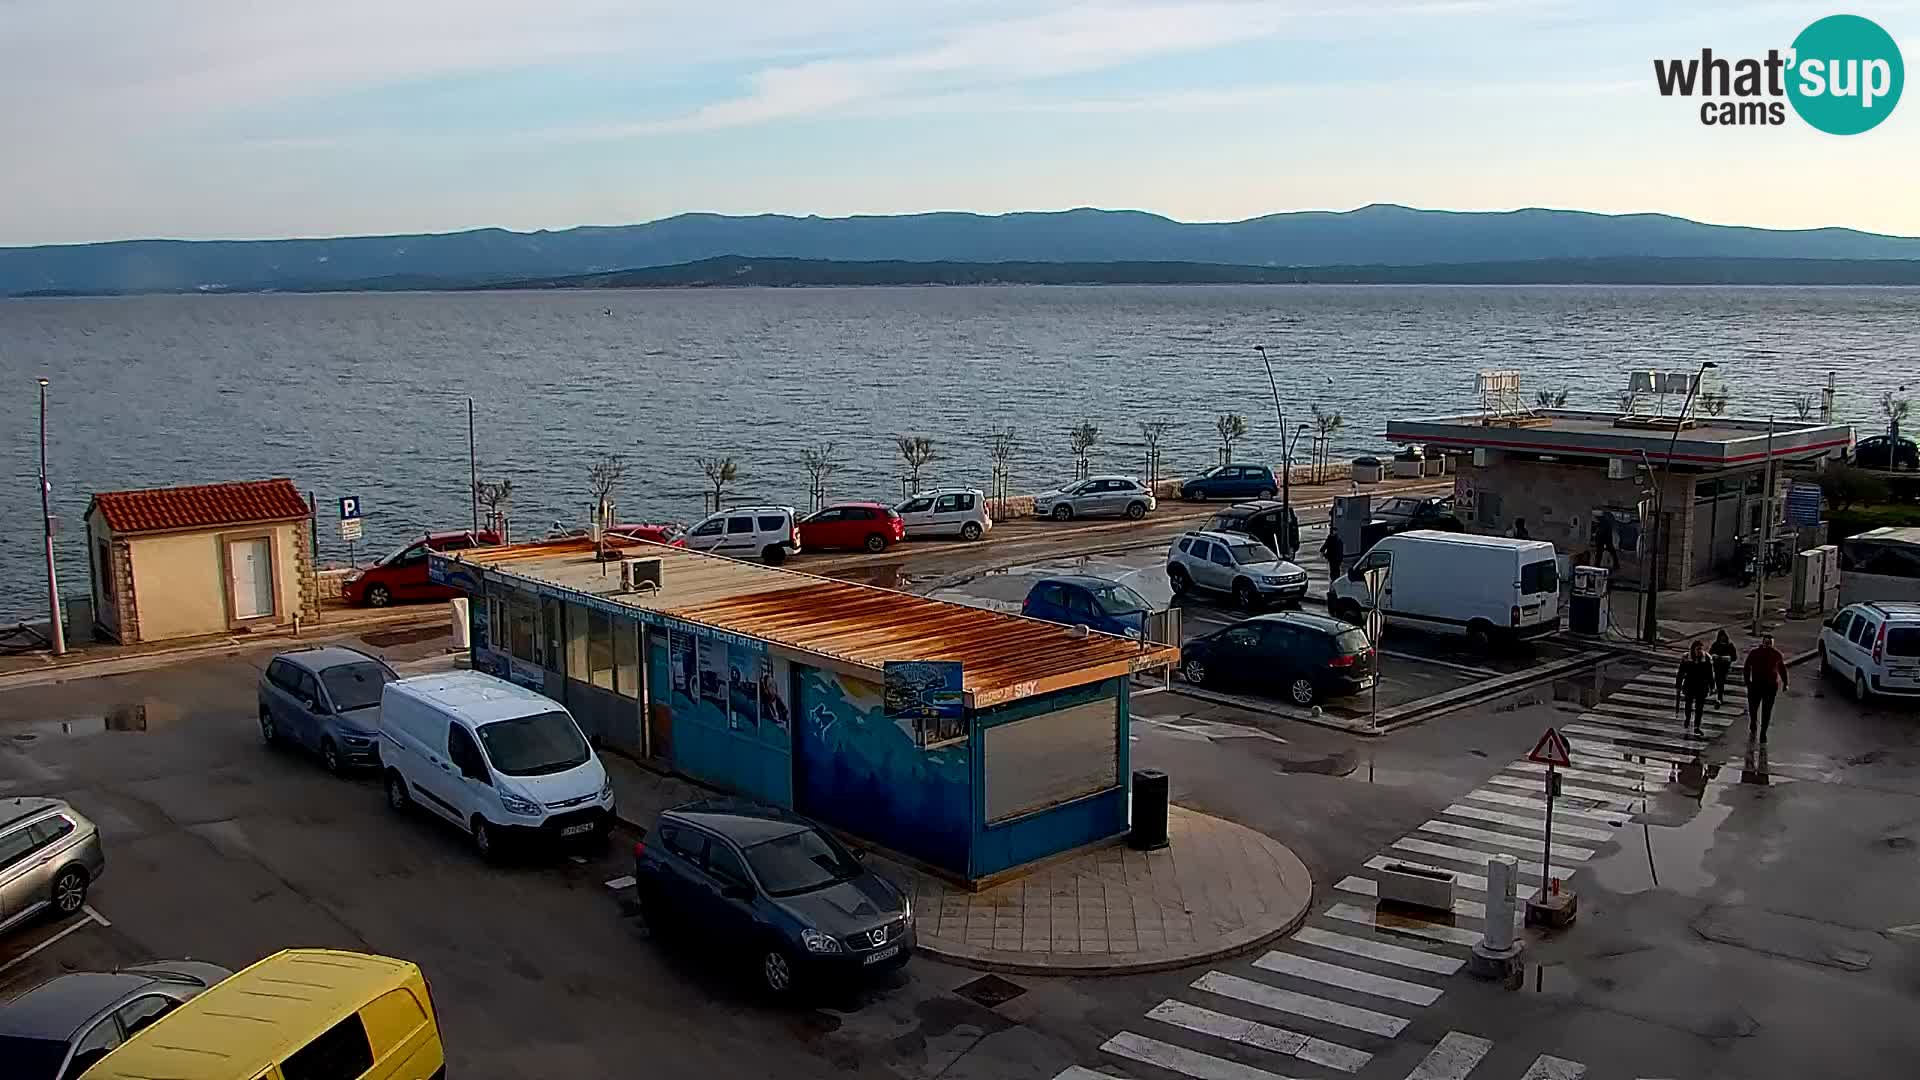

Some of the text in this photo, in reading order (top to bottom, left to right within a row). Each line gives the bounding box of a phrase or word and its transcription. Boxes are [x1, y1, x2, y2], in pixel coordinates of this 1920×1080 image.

[343, 499, 355, 516] P
[712, 629, 736, 644] TICKET
[738, 637, 763, 651] OFFICE
